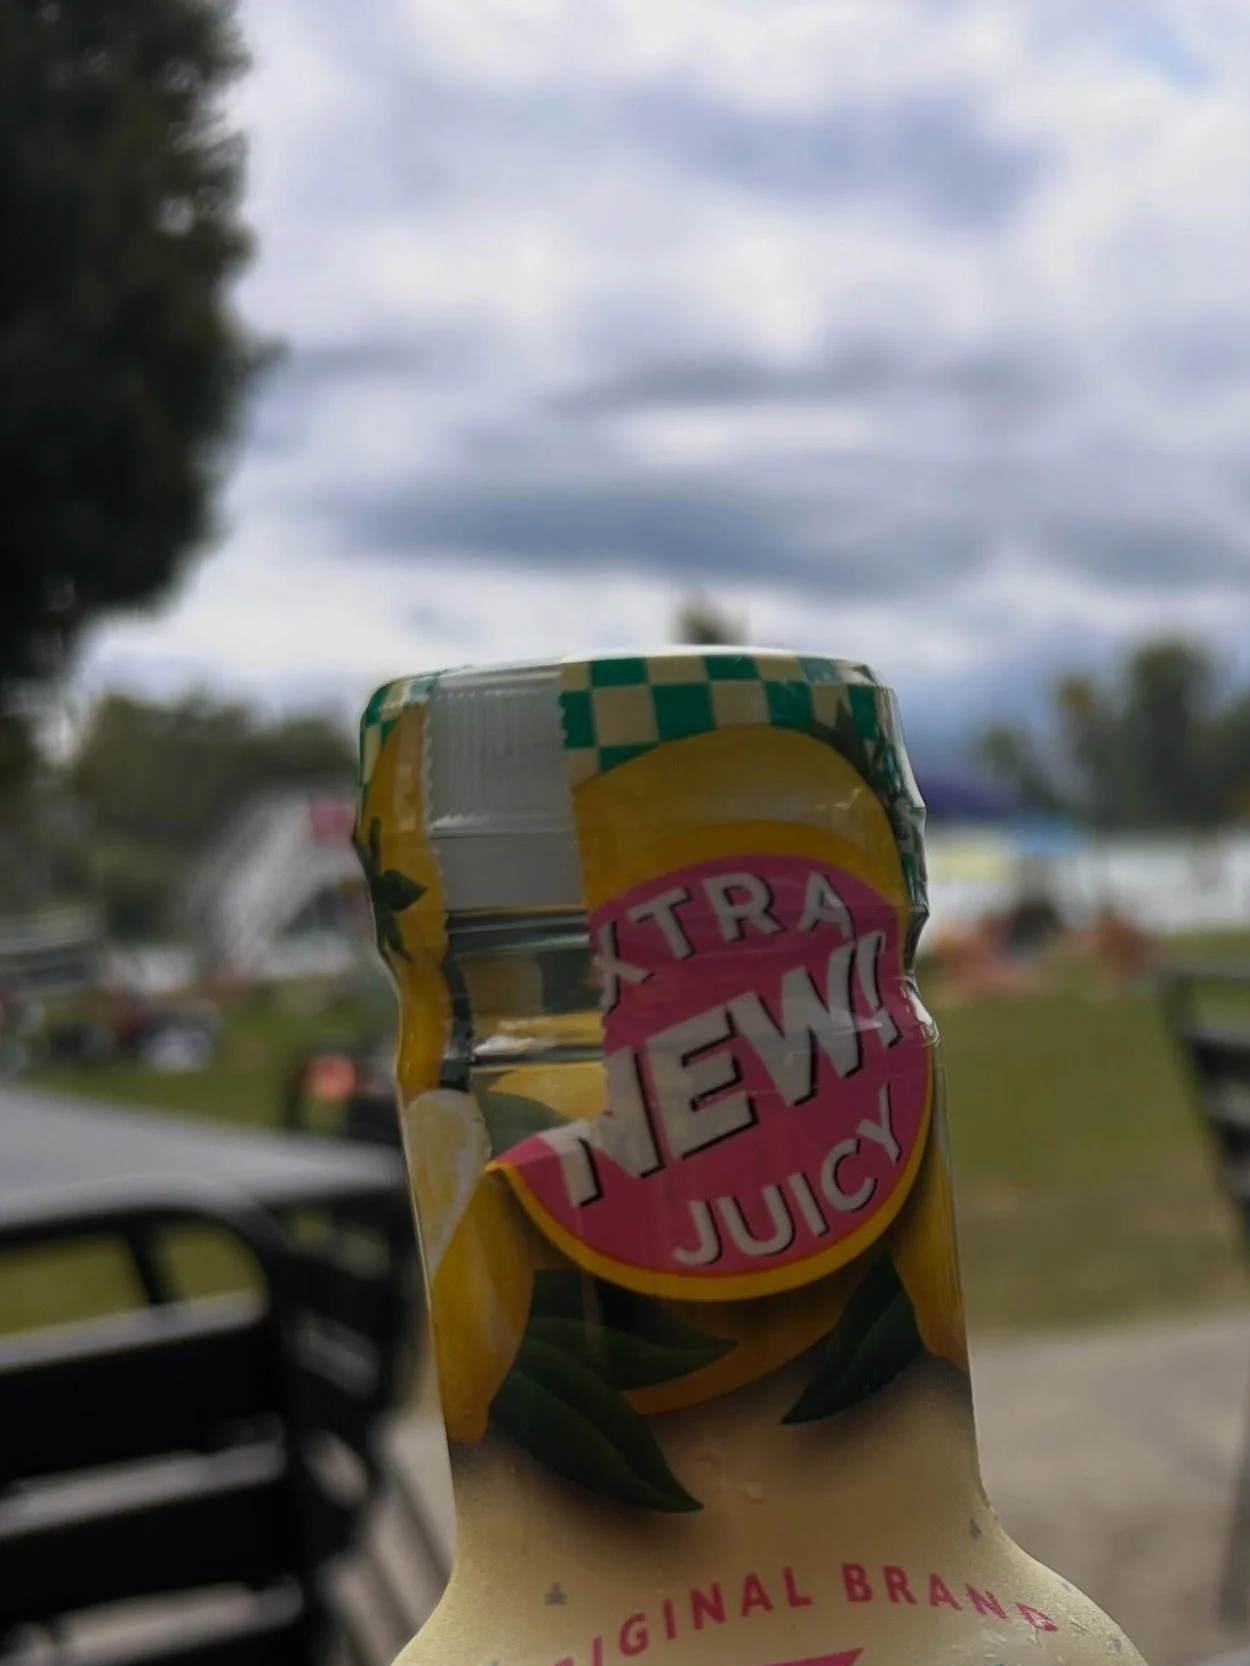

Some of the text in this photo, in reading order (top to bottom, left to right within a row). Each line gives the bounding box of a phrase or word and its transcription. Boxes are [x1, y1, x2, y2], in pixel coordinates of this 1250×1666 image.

[544, 932, 901, 1208] NEW!
[672, 1083, 901, 1266] JUICY
[841, 1563, 1058, 1632] BRAND
